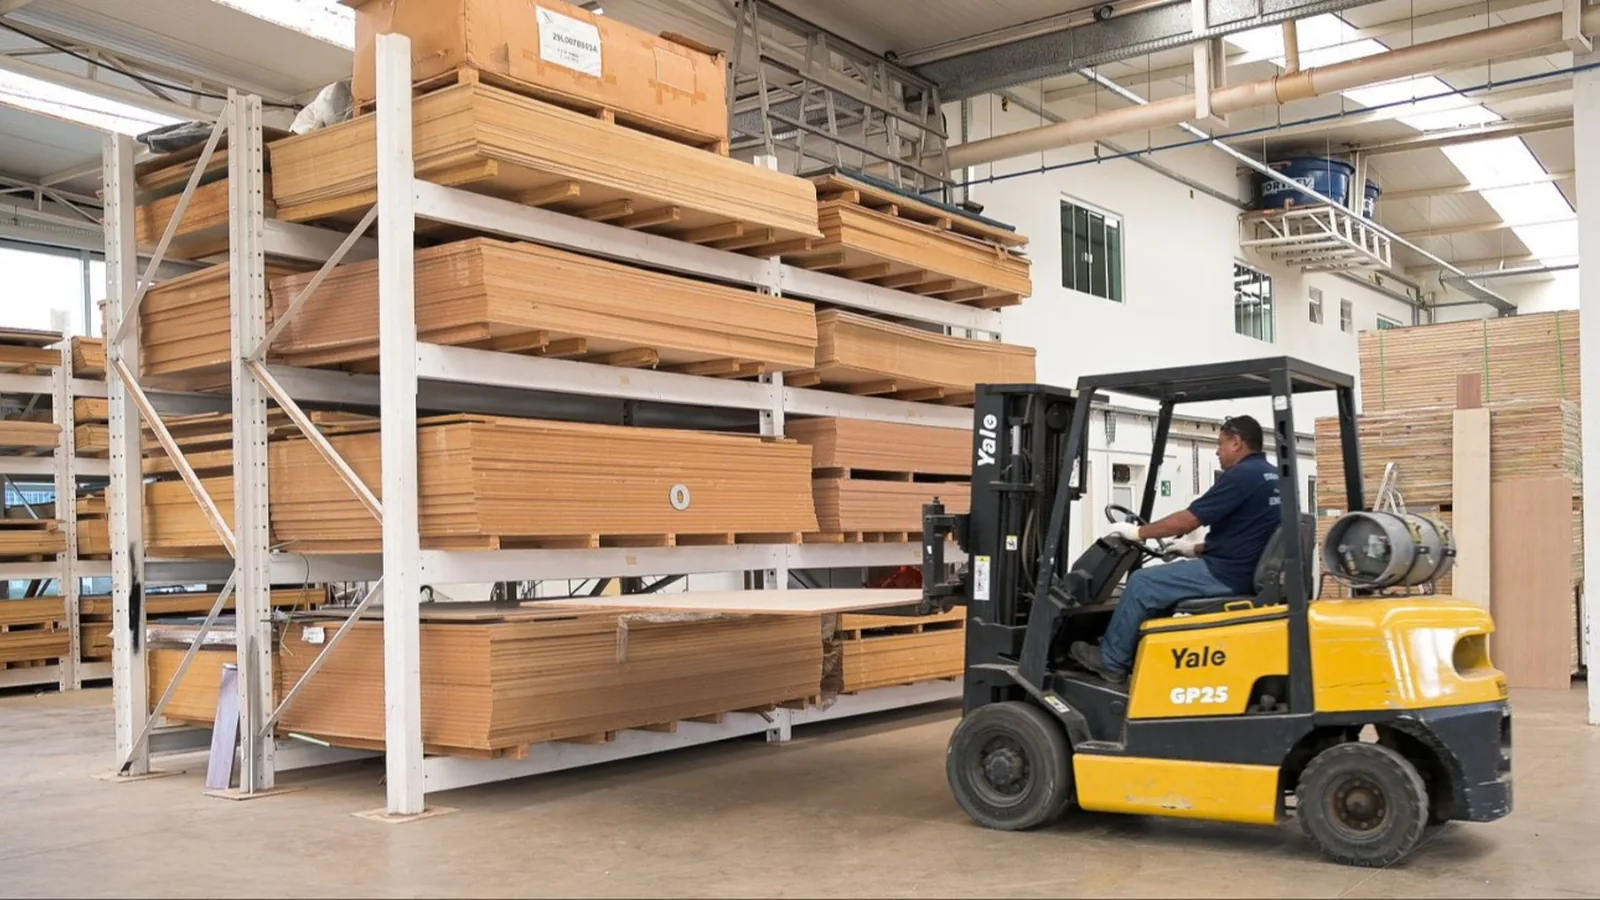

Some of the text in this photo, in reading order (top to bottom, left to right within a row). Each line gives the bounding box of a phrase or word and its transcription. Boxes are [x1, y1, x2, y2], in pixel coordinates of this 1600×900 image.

[977, 414, 997, 466] Yale
[1171, 646, 1226, 669] Yale
[1170, 686, 1228, 704] GP25
